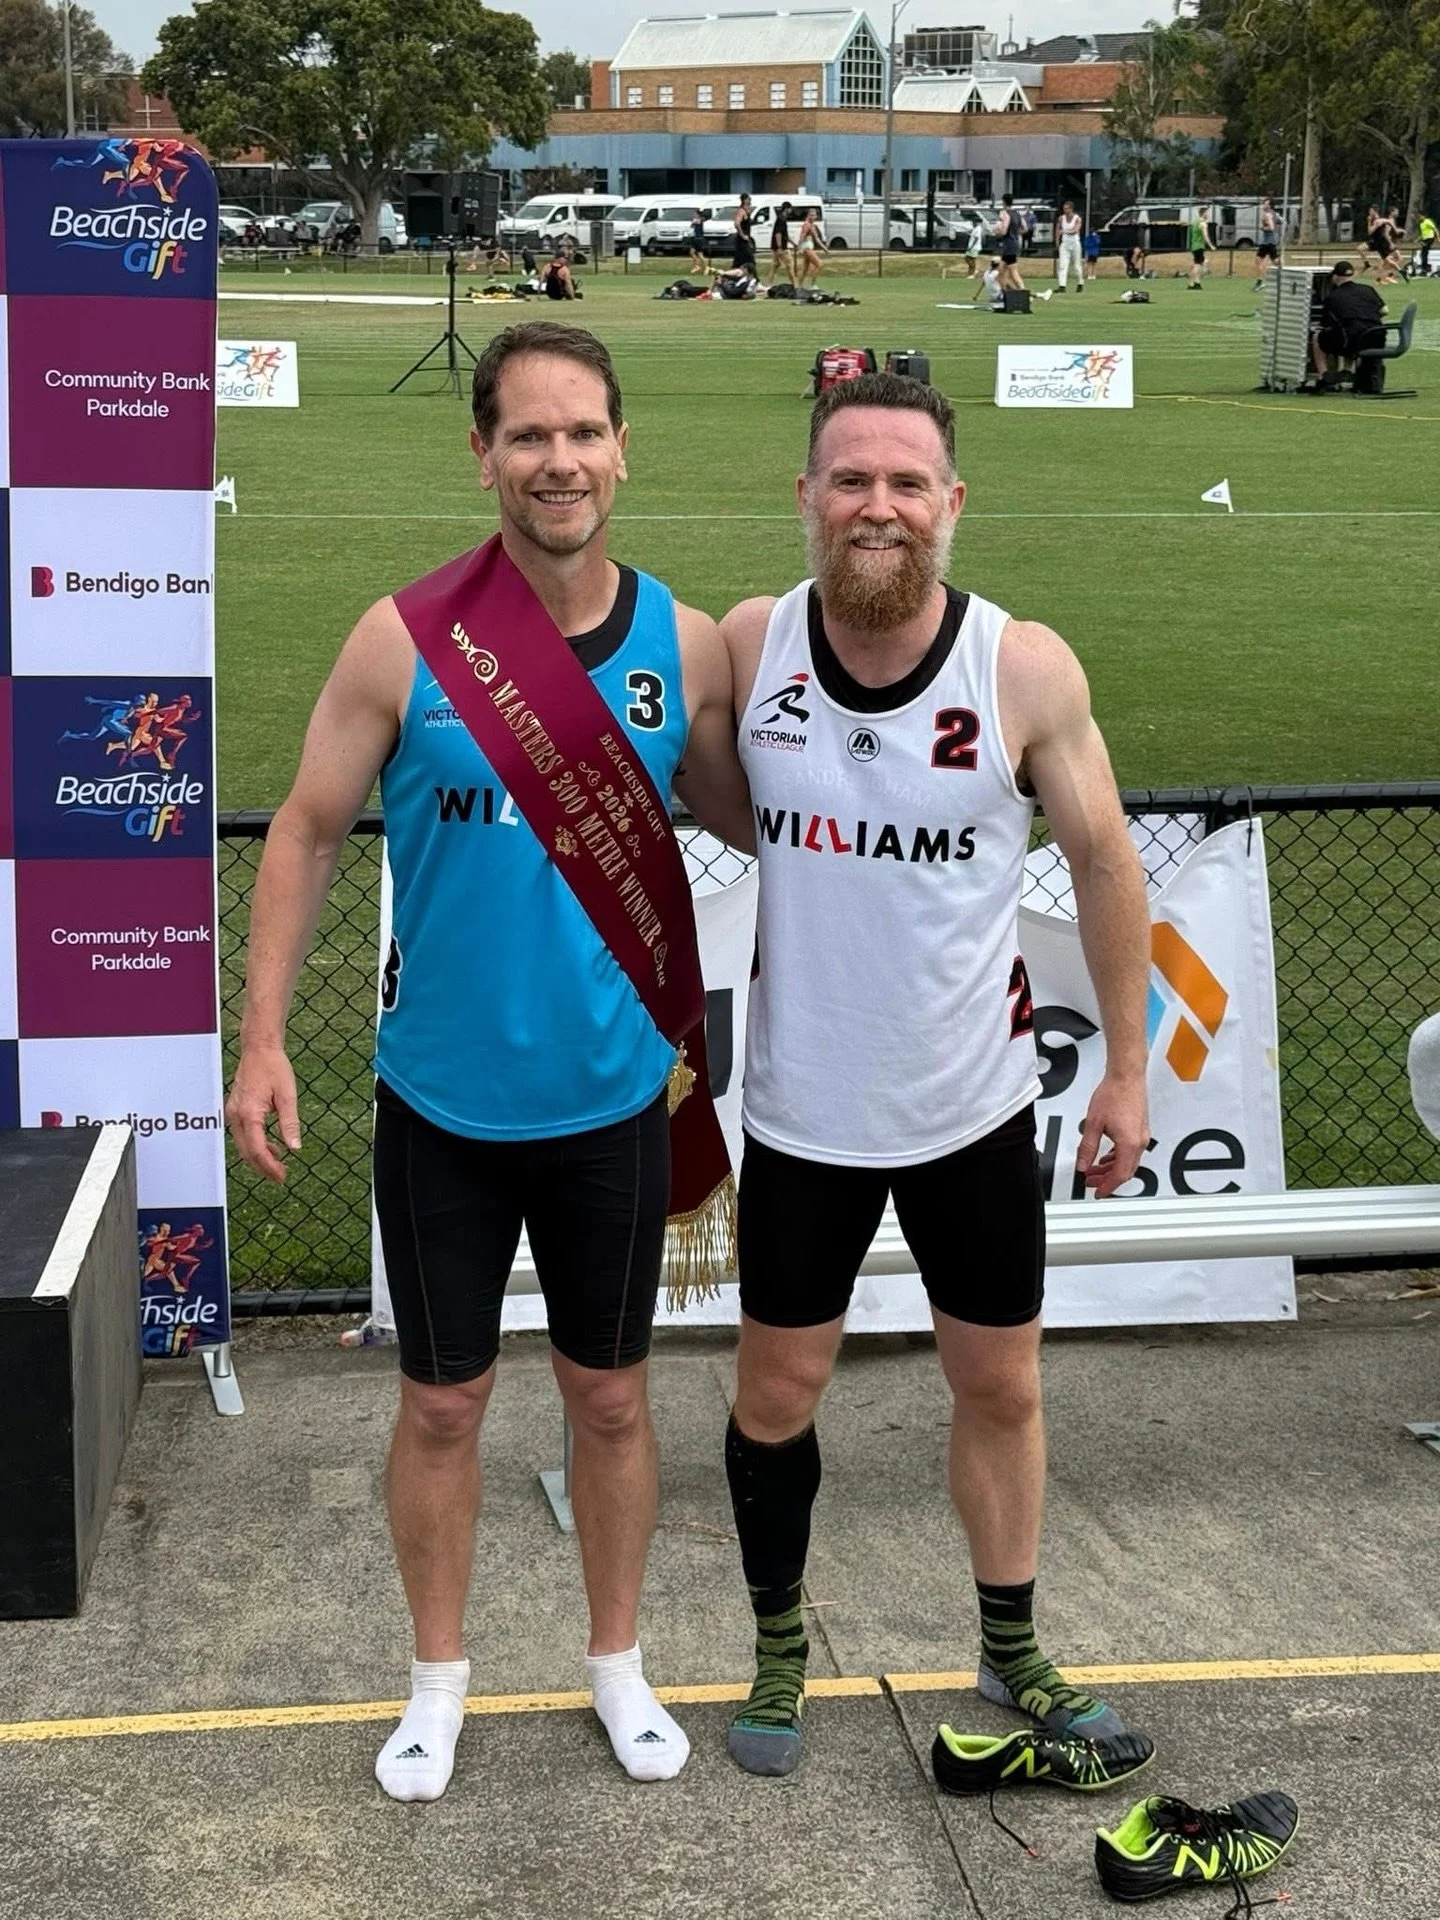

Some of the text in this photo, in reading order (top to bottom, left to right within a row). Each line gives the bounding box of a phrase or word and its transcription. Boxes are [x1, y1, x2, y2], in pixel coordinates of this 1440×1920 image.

[50, 204, 207, 241] Beachside
[124, 241, 187, 280] Gift
[45, 370, 210, 393] Community Bank
[87, 399, 170, 418] Parkdale
[66, 572, 159, 598] Bendigo
[166, 573, 213, 594] Ban
[626, 669, 666, 732] 3
[750, 729, 807, 746] VICTORIAN
[930, 707, 980, 771] 2
[55, 772, 204, 804] Beachside
[600, 733, 666, 841] BEACHSIDE GIFT
[124, 804, 186, 843] Gift
[489, 679, 662, 947] MASTERS 300 METRE WINNER
[596, 784, 634, 833] 2026
[756, 805, 977, 863] WILLIAMS
[51, 926, 210, 947] Community Bank
[92, 953, 171, 970] Parkdale
[174, 1109, 222, 1130] Ban
[140, 1295, 218, 1325] hside
